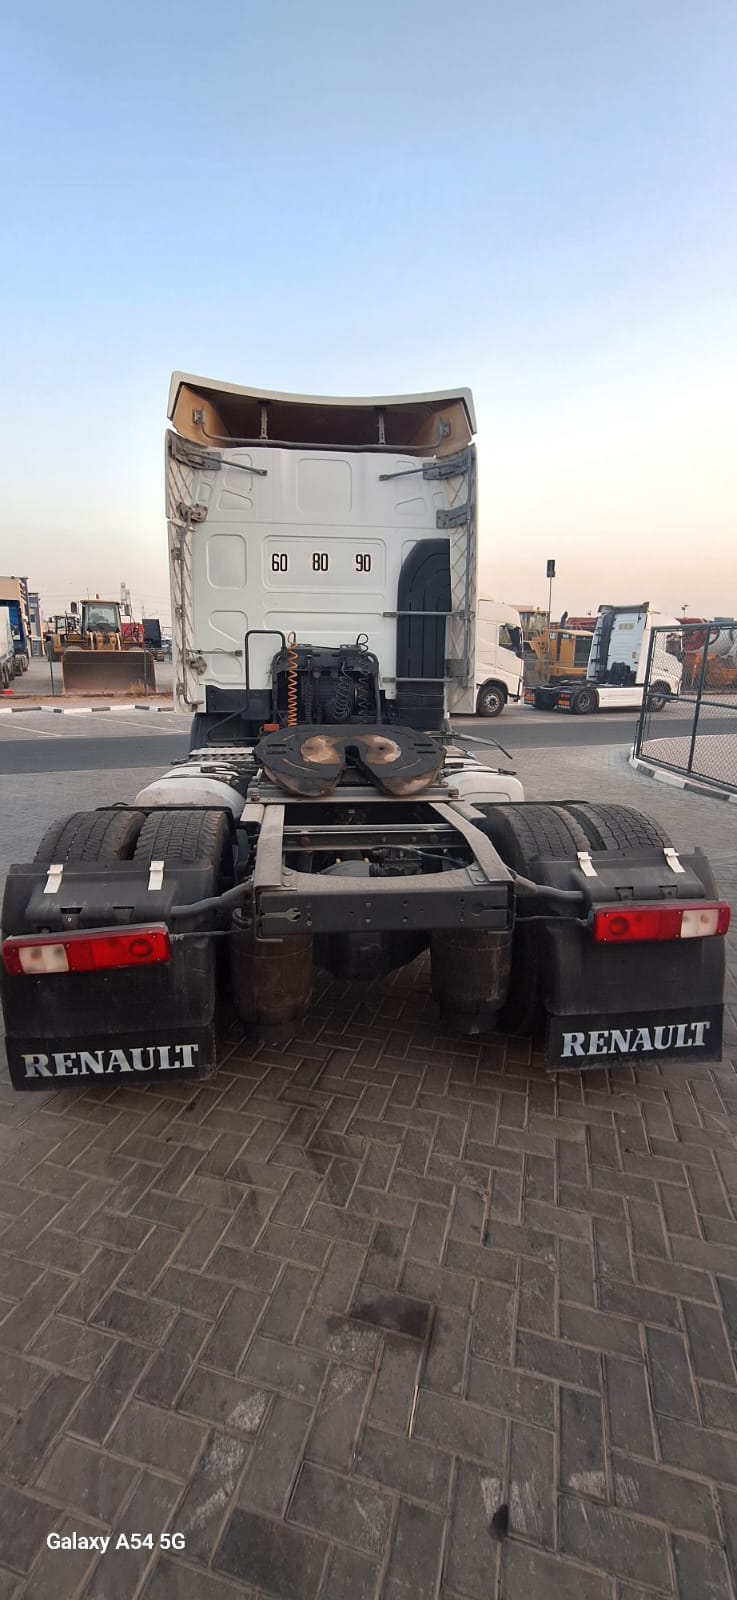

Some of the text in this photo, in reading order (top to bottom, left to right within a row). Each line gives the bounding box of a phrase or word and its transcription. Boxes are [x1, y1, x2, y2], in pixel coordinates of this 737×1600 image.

[272, 553, 370, 572] 60 80 90
[560, 1021, 711, 1057] RENAULT
[21, 1043, 199, 1078] RENAULT
